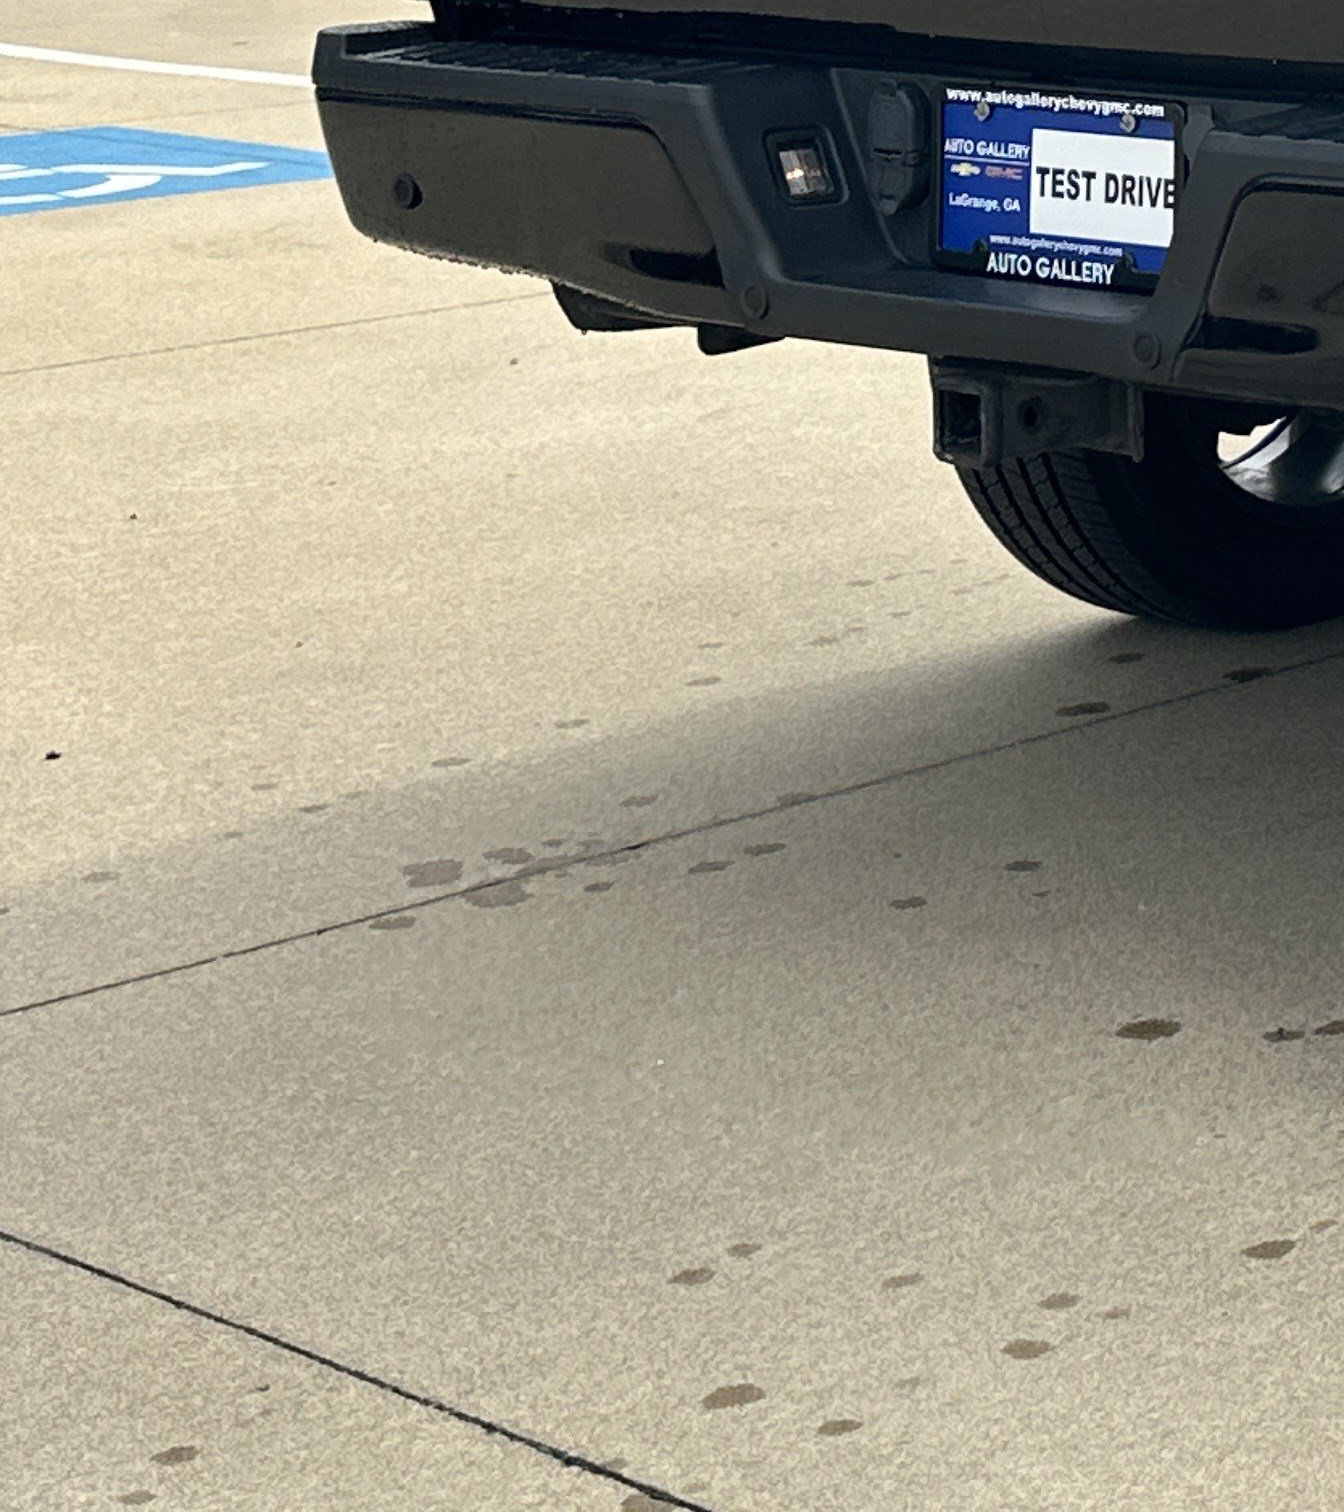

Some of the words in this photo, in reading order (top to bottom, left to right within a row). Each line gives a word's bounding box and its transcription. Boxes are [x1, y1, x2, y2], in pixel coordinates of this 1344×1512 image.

[945, 87, 1166, 118] www.autogallerychevygmc.com
[944, 138, 975, 156] AUTO
[976, 140, 1031, 161] GALLERY
[948, 192, 1001, 213] LaGrange,
[1003, 198, 1022, 213] GA
[1035, 166, 1097, 202] TEST
[1104, 172, 1177, 210] DRIVE
[985, 251, 1033, 278] AUTO
[1034, 256, 1116, 286] GALLERY
